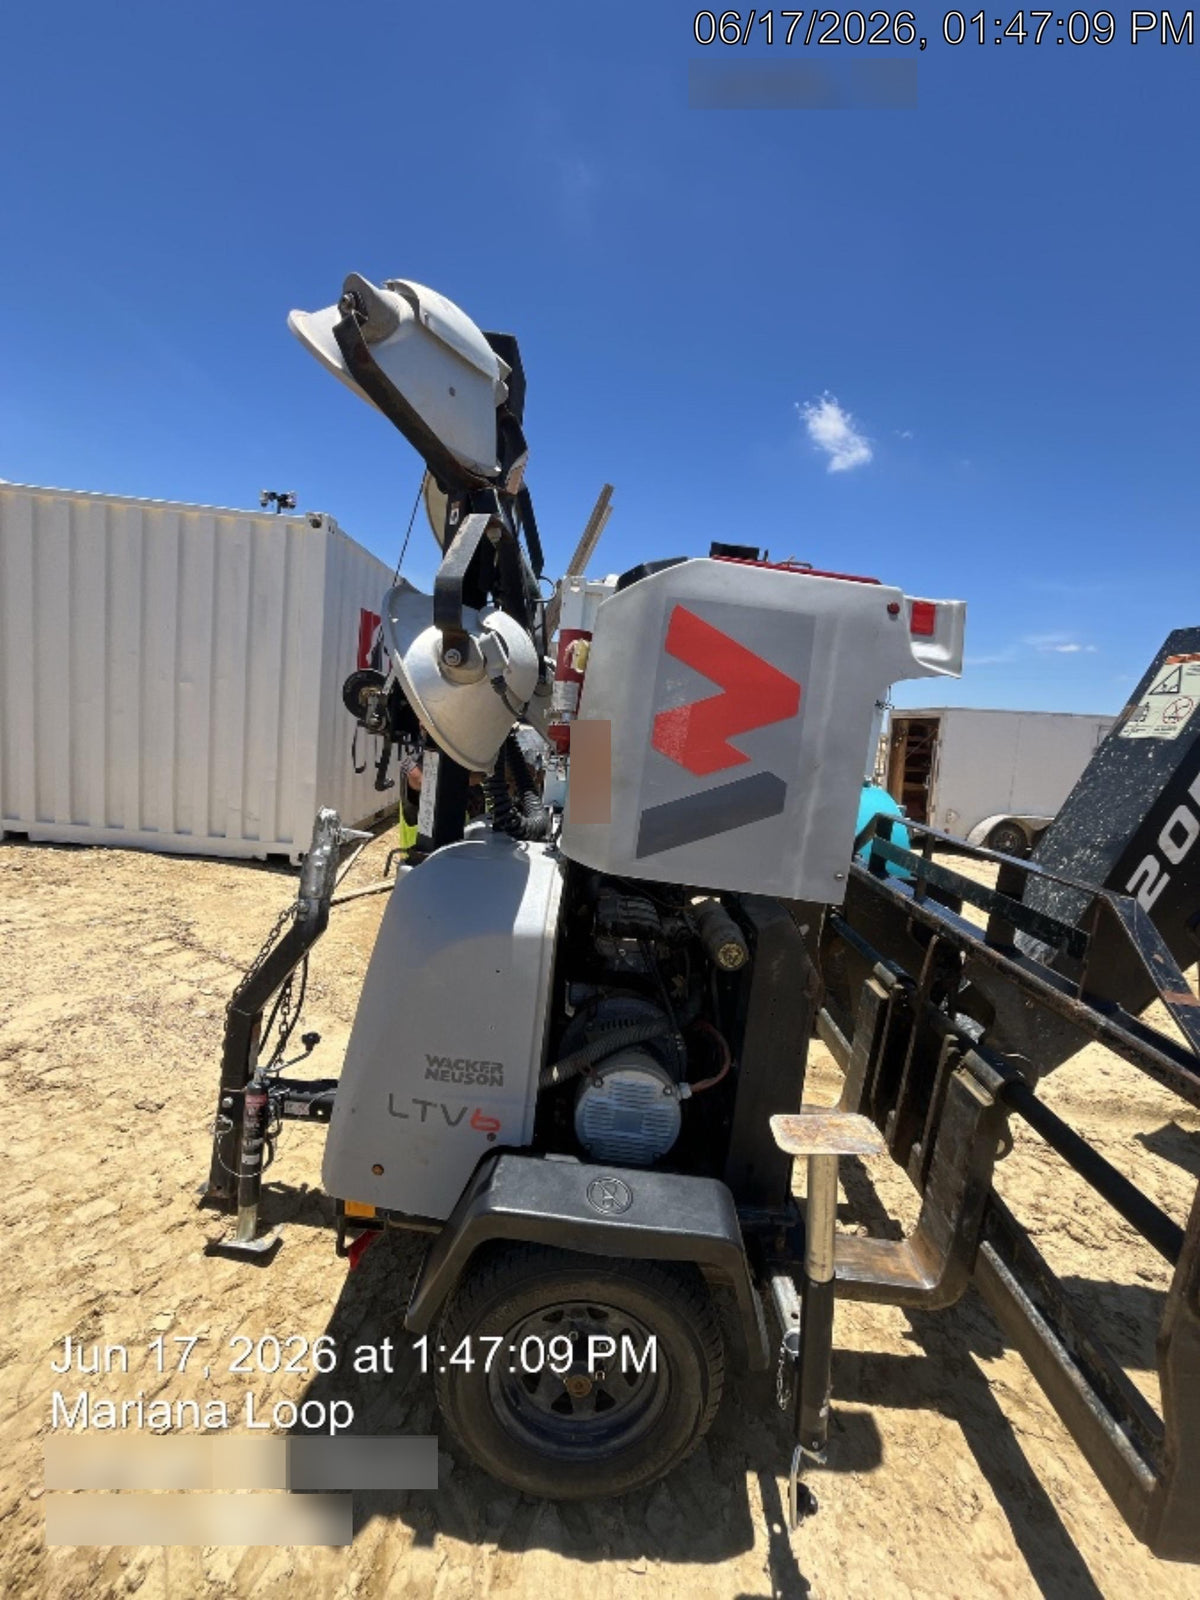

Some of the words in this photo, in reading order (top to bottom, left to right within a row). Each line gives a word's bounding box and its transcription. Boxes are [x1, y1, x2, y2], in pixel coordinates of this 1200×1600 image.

[1125, 772, 1200, 915] 20
[424, 1068, 504, 1087] NEUSON
[425, 1054, 504, 1075] WACKER
[387, 1093, 501, 1132] LTV6
